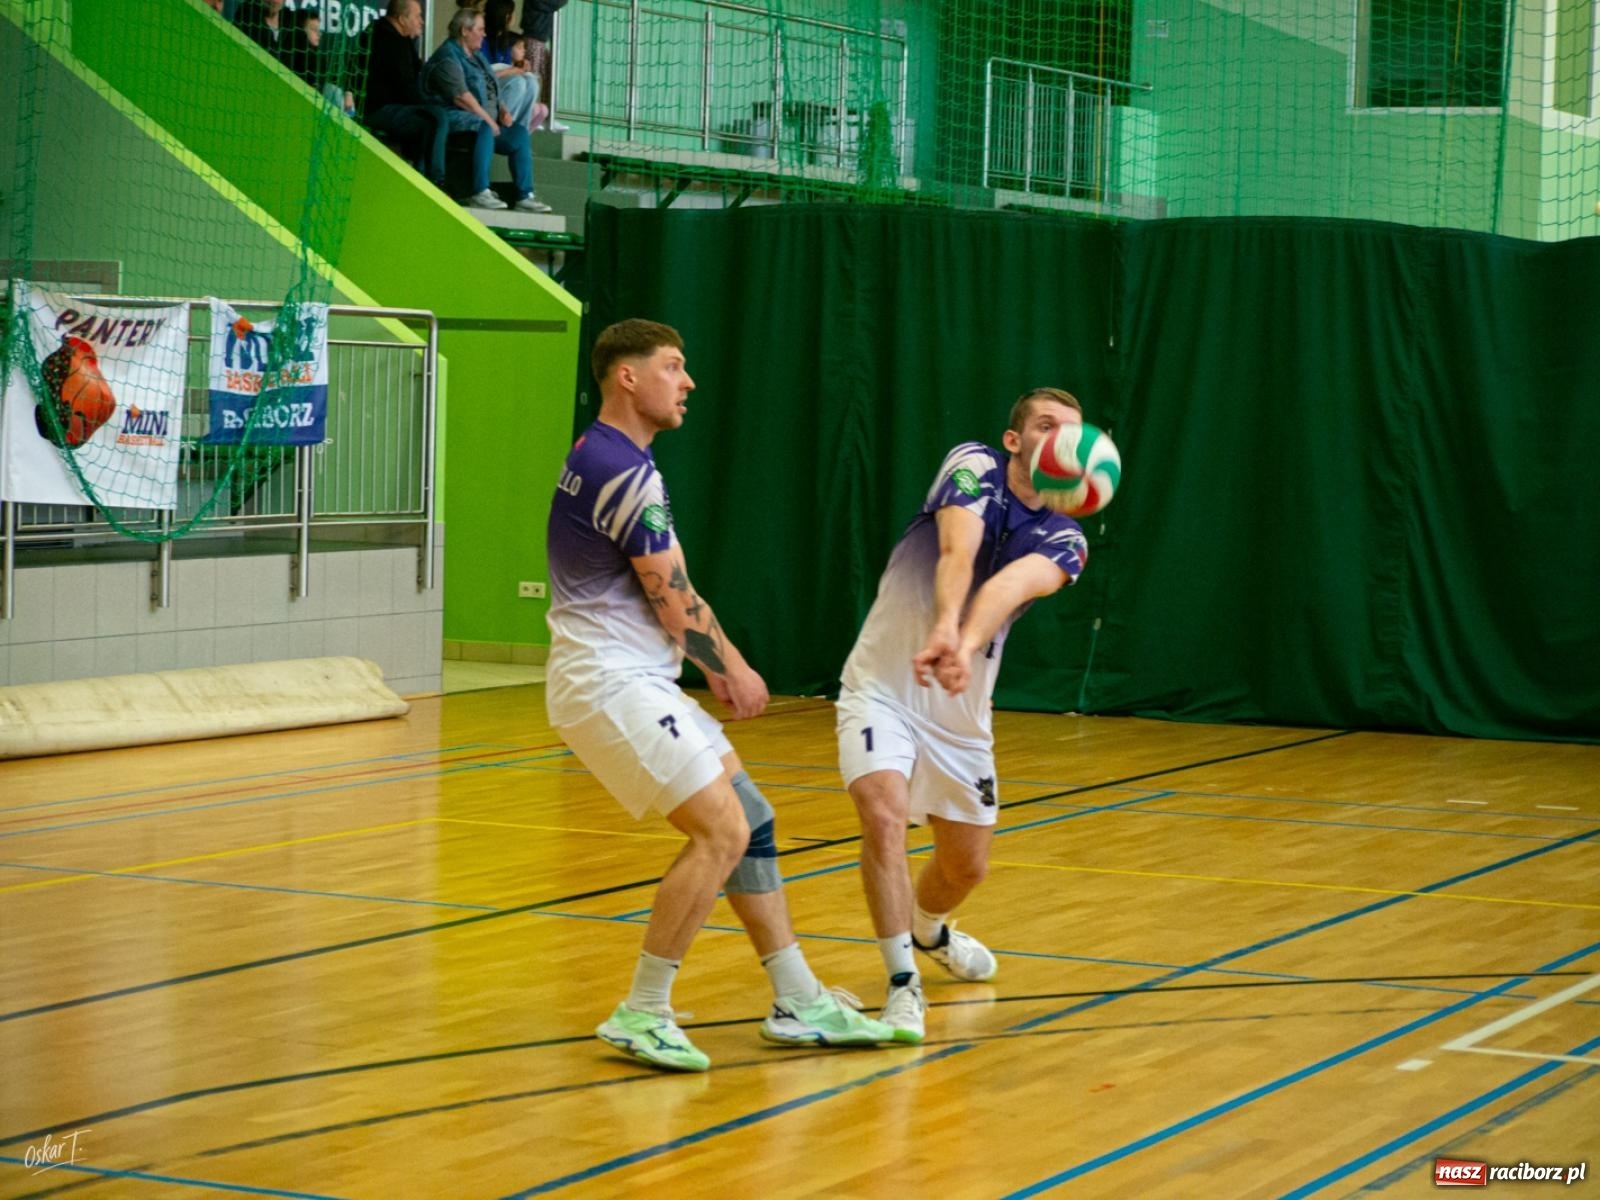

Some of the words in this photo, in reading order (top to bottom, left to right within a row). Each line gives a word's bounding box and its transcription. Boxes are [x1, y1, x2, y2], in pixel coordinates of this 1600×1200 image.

[121, 409, 169, 436] MINI
[658, 714, 680, 739] 7
[860, 726, 875, 752] 1
